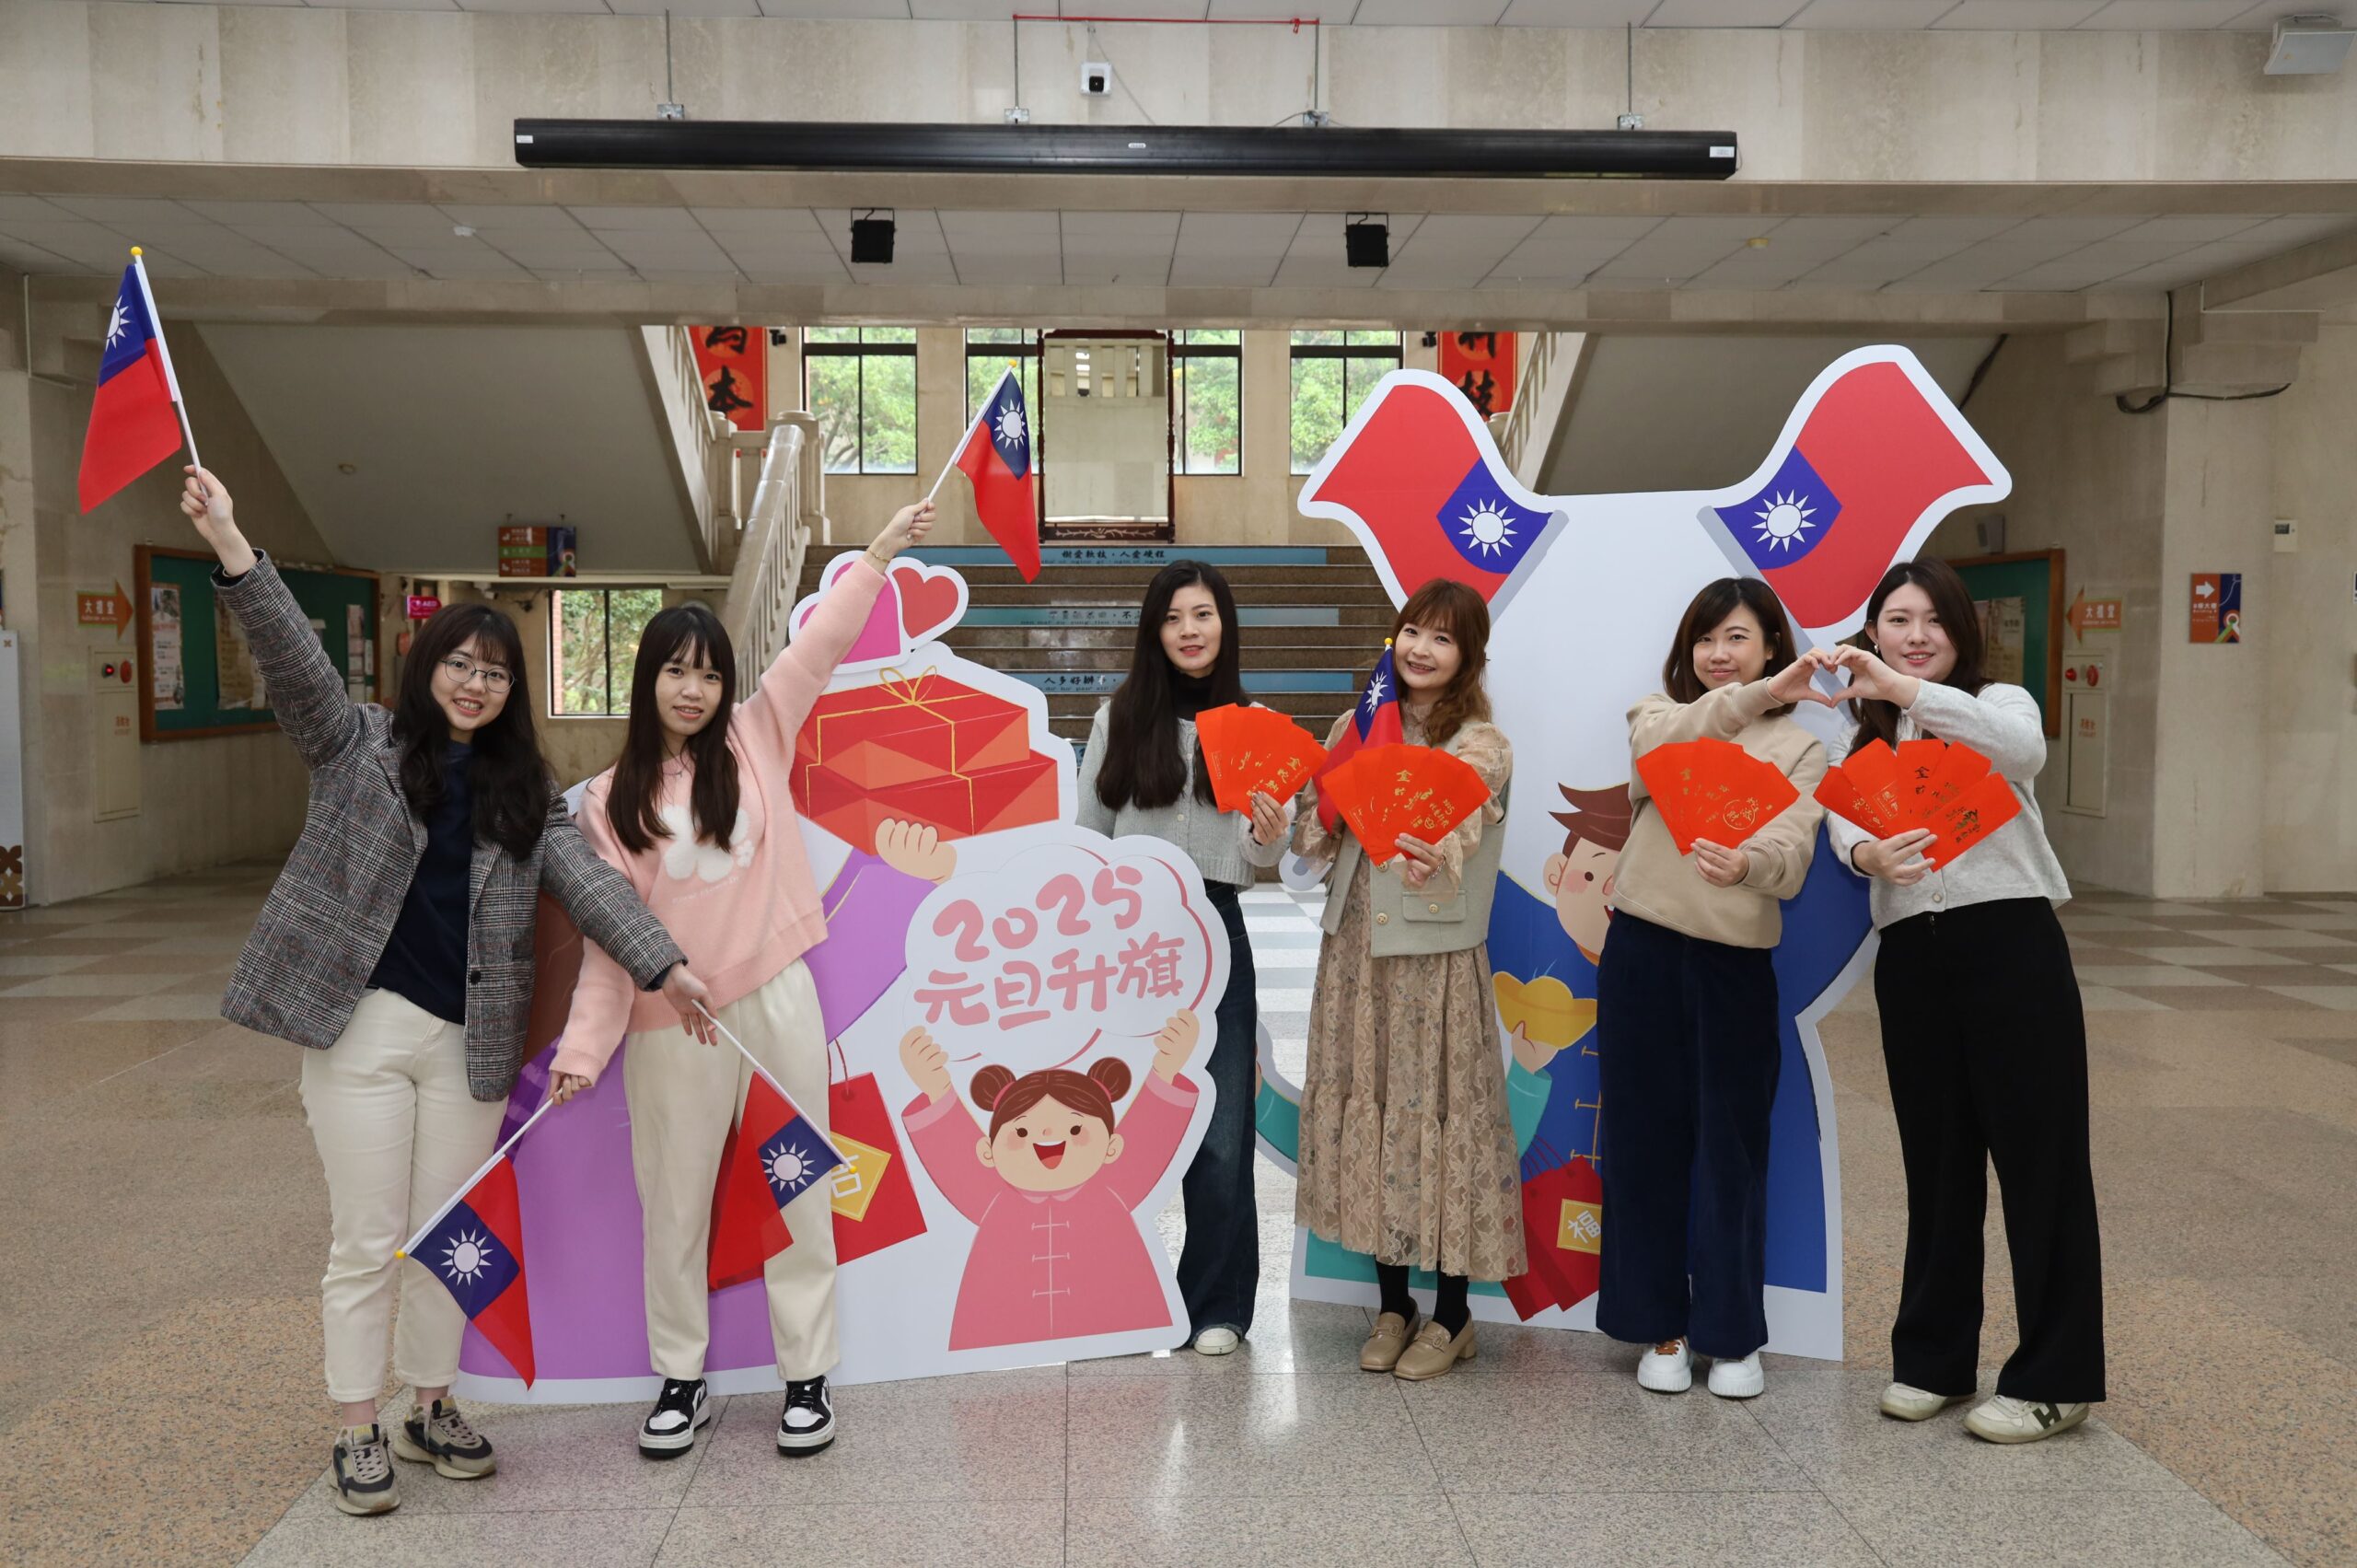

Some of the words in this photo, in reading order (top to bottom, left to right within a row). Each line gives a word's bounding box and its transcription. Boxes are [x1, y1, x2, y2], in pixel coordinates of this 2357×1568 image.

[932, 865, 1144, 963] 2025
[913, 931, 1185, 1031] 元旦升旗
[1567, 1210, 1602, 1244] 福
